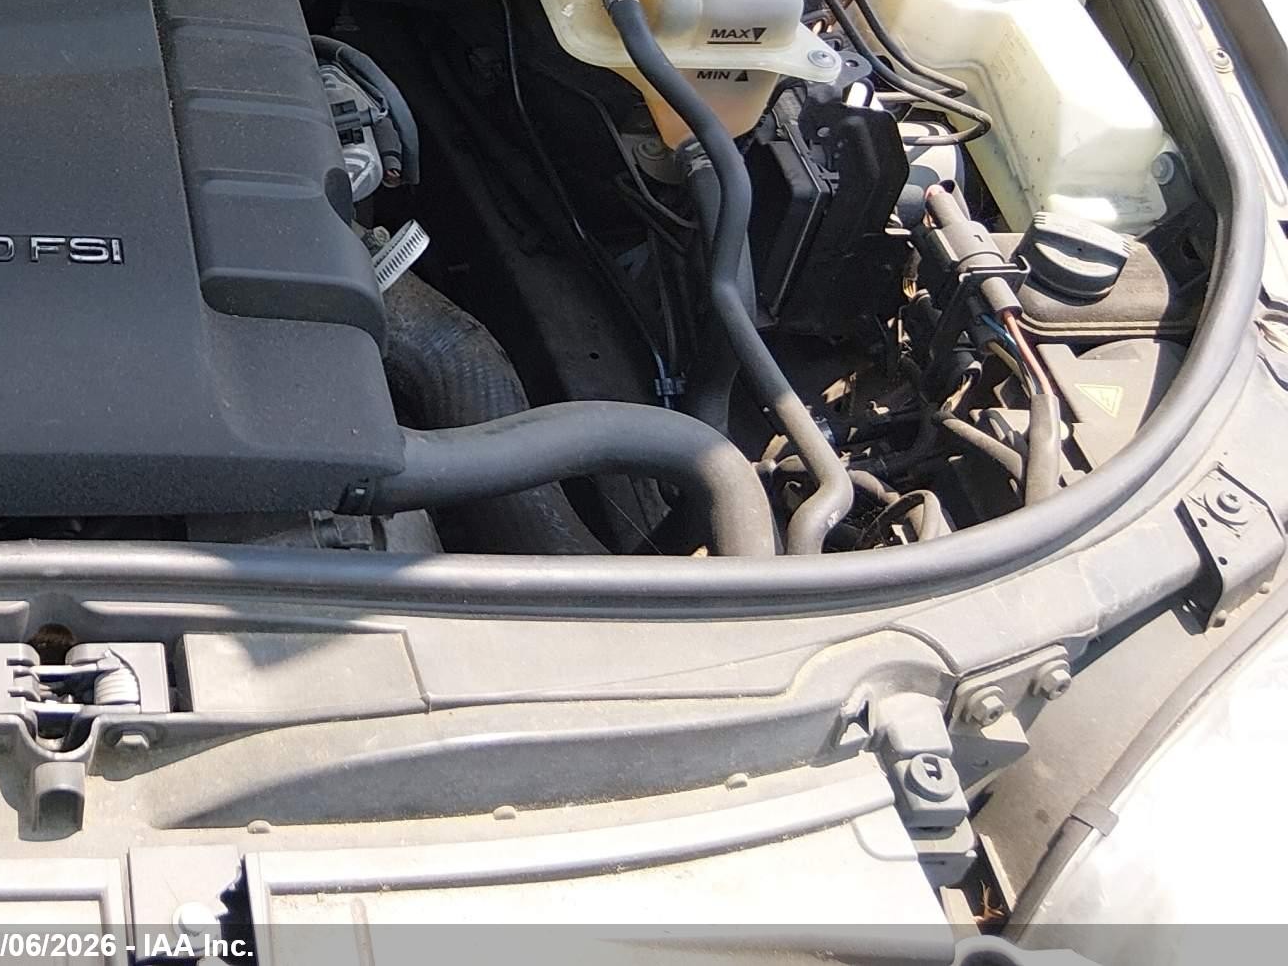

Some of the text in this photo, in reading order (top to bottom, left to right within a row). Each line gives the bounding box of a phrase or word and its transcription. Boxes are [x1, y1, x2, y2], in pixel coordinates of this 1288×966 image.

[710, 28, 751, 40] MAX
[696, 70, 731, 81] MIN
[30, 237, 124, 264] FSI
